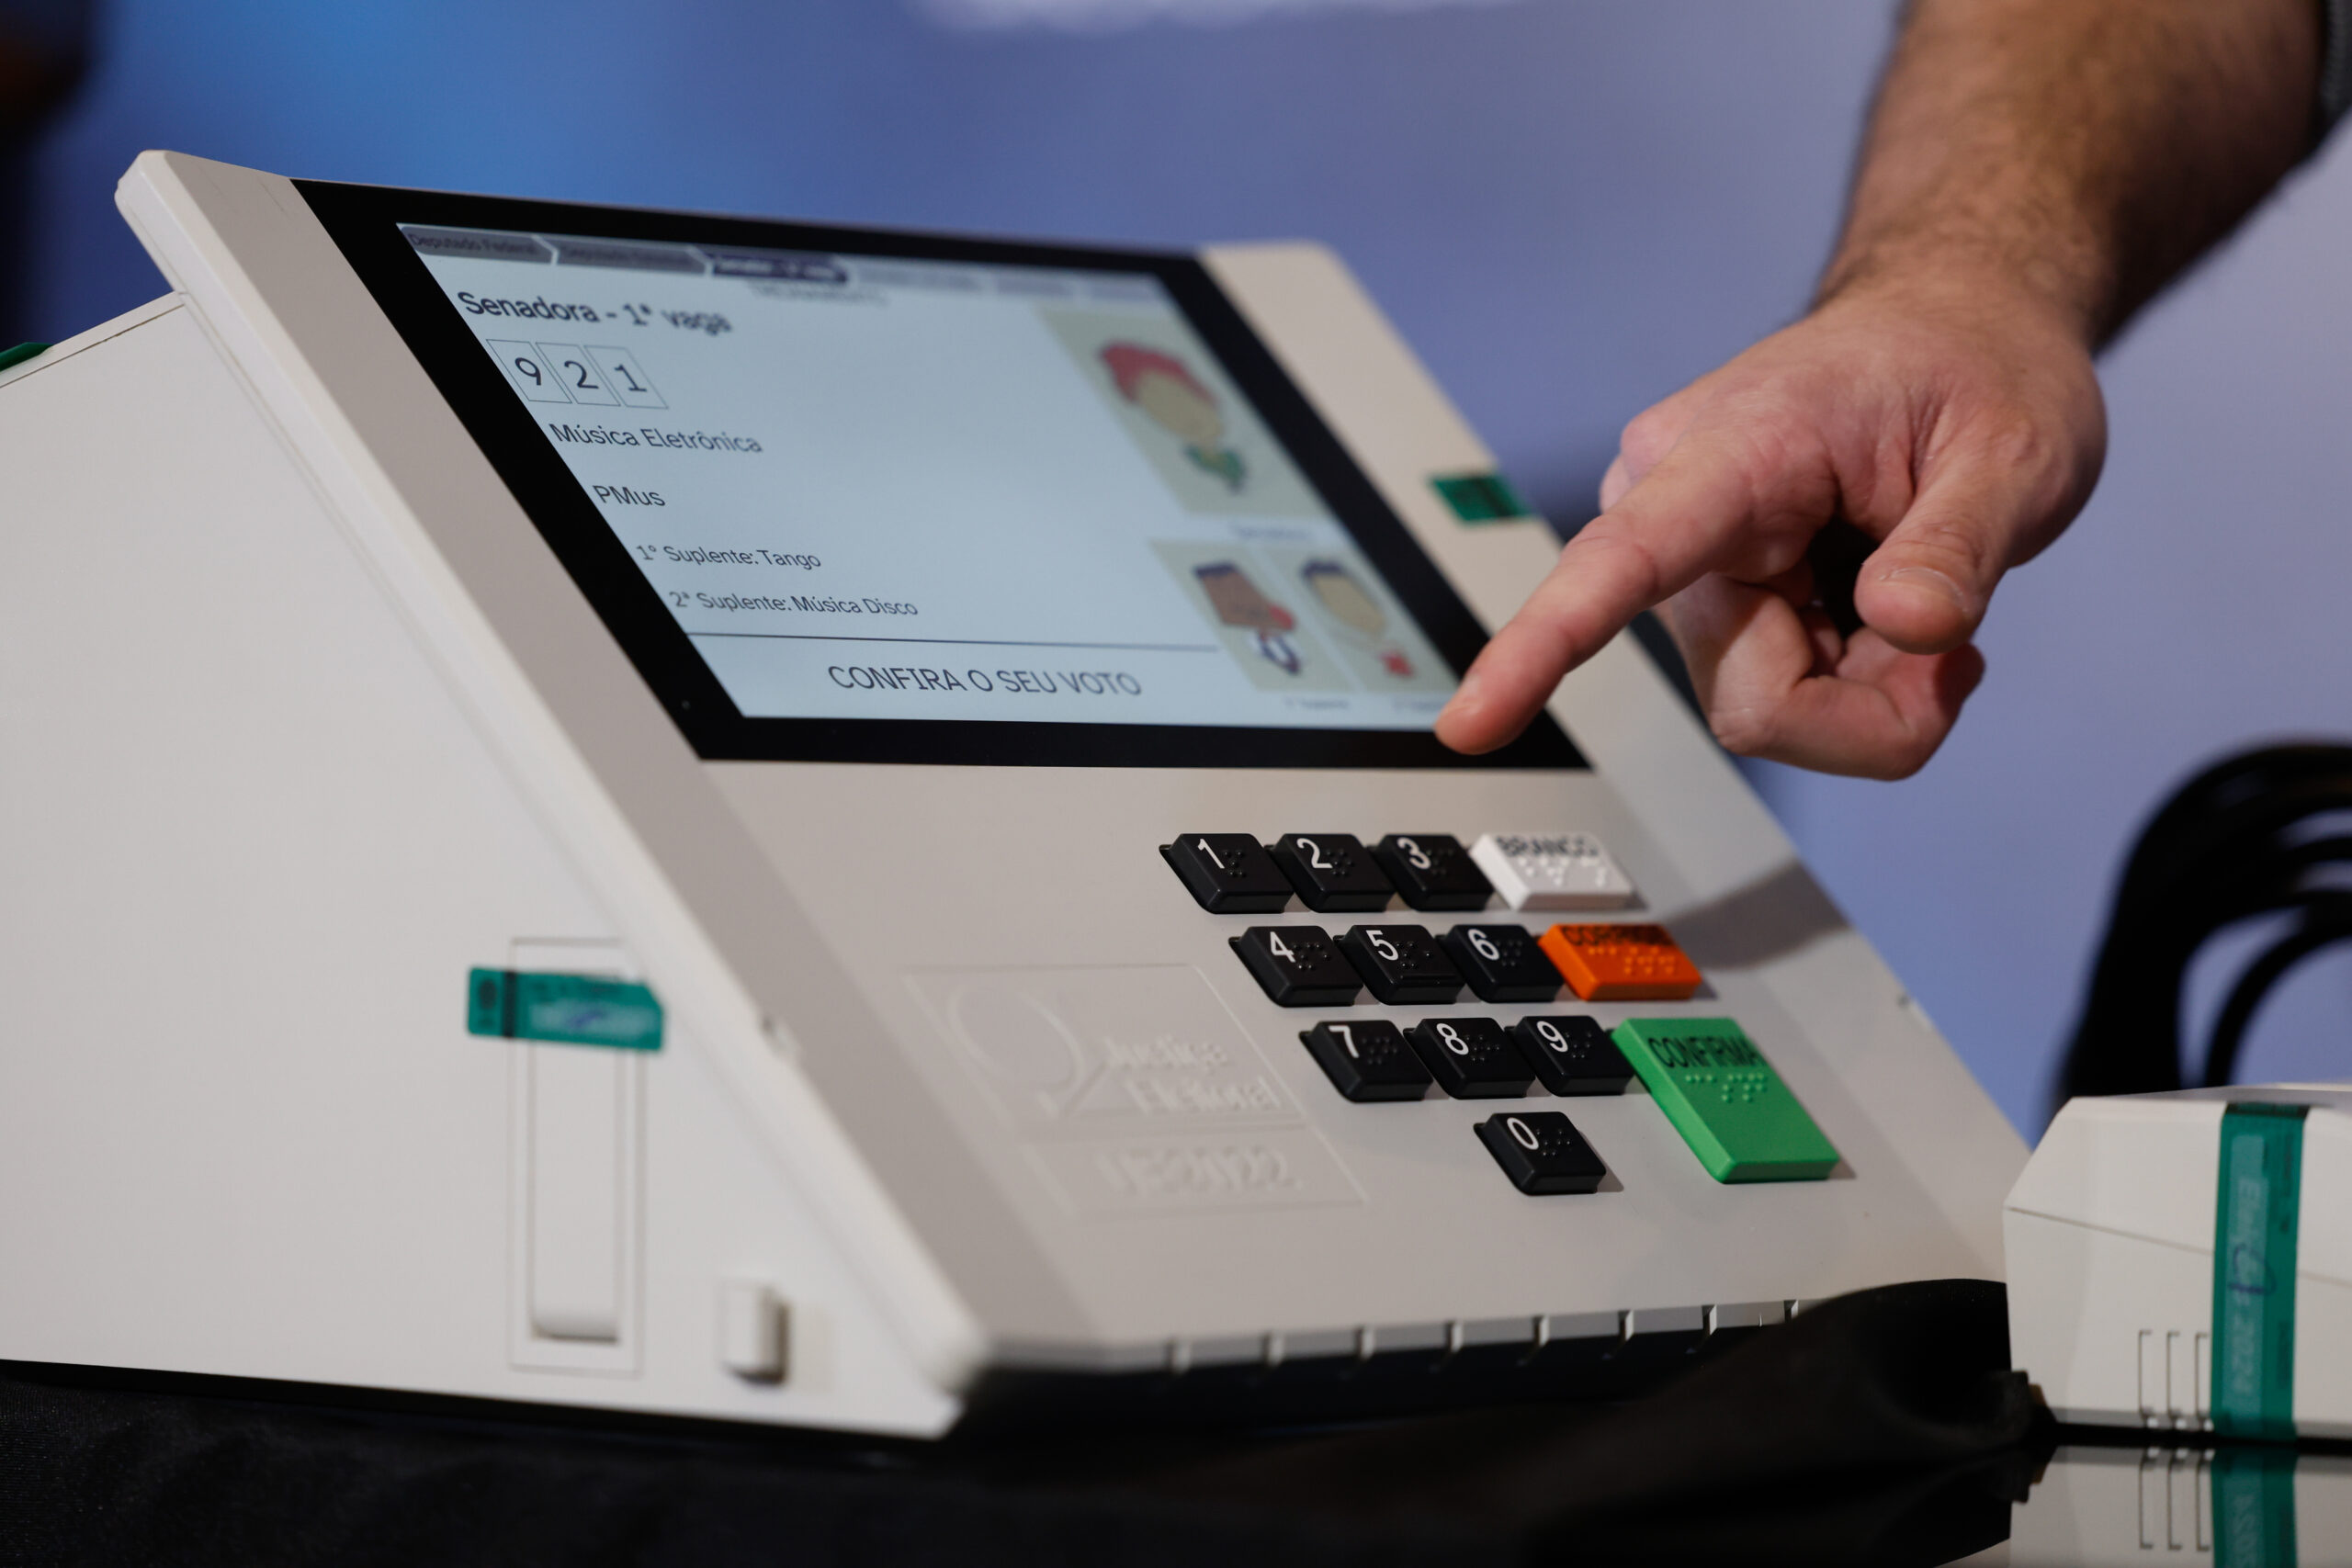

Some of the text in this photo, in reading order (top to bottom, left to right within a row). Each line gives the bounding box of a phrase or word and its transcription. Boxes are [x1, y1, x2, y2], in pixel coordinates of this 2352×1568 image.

[458, 291, 600, 322] Senadora
[661, 309, 732, 336] vaga
[549, 423, 763, 453] Música Eletrônica
[593, 484, 666, 507] PMus
[663, 546, 759, 566] Suplente:
[757, 549, 821, 569] Tango
[696, 592, 791, 613] Suplente:
[793, 595, 863, 615] Música
[863, 598, 919, 616] Disco
[827, 665, 1142, 696] CONFIRA O SEU VOTO
[1197, 838, 1226, 870] 1
[1296, 838, 1333, 870] 2
[1396, 837, 1431, 870] 3
[1270, 931, 1295, 963] 4
[1367, 930, 1398, 961] 5
[1467, 929, 1499, 960] 6
[1328, 1025, 1359, 1057] 7
[1436, 1022, 1469, 1055] 8
[1536, 1021, 1568, 1053] 9
[1647, 1037, 1765, 1068] CONFIRMA
[1507, 1117, 1539, 1150] 0
